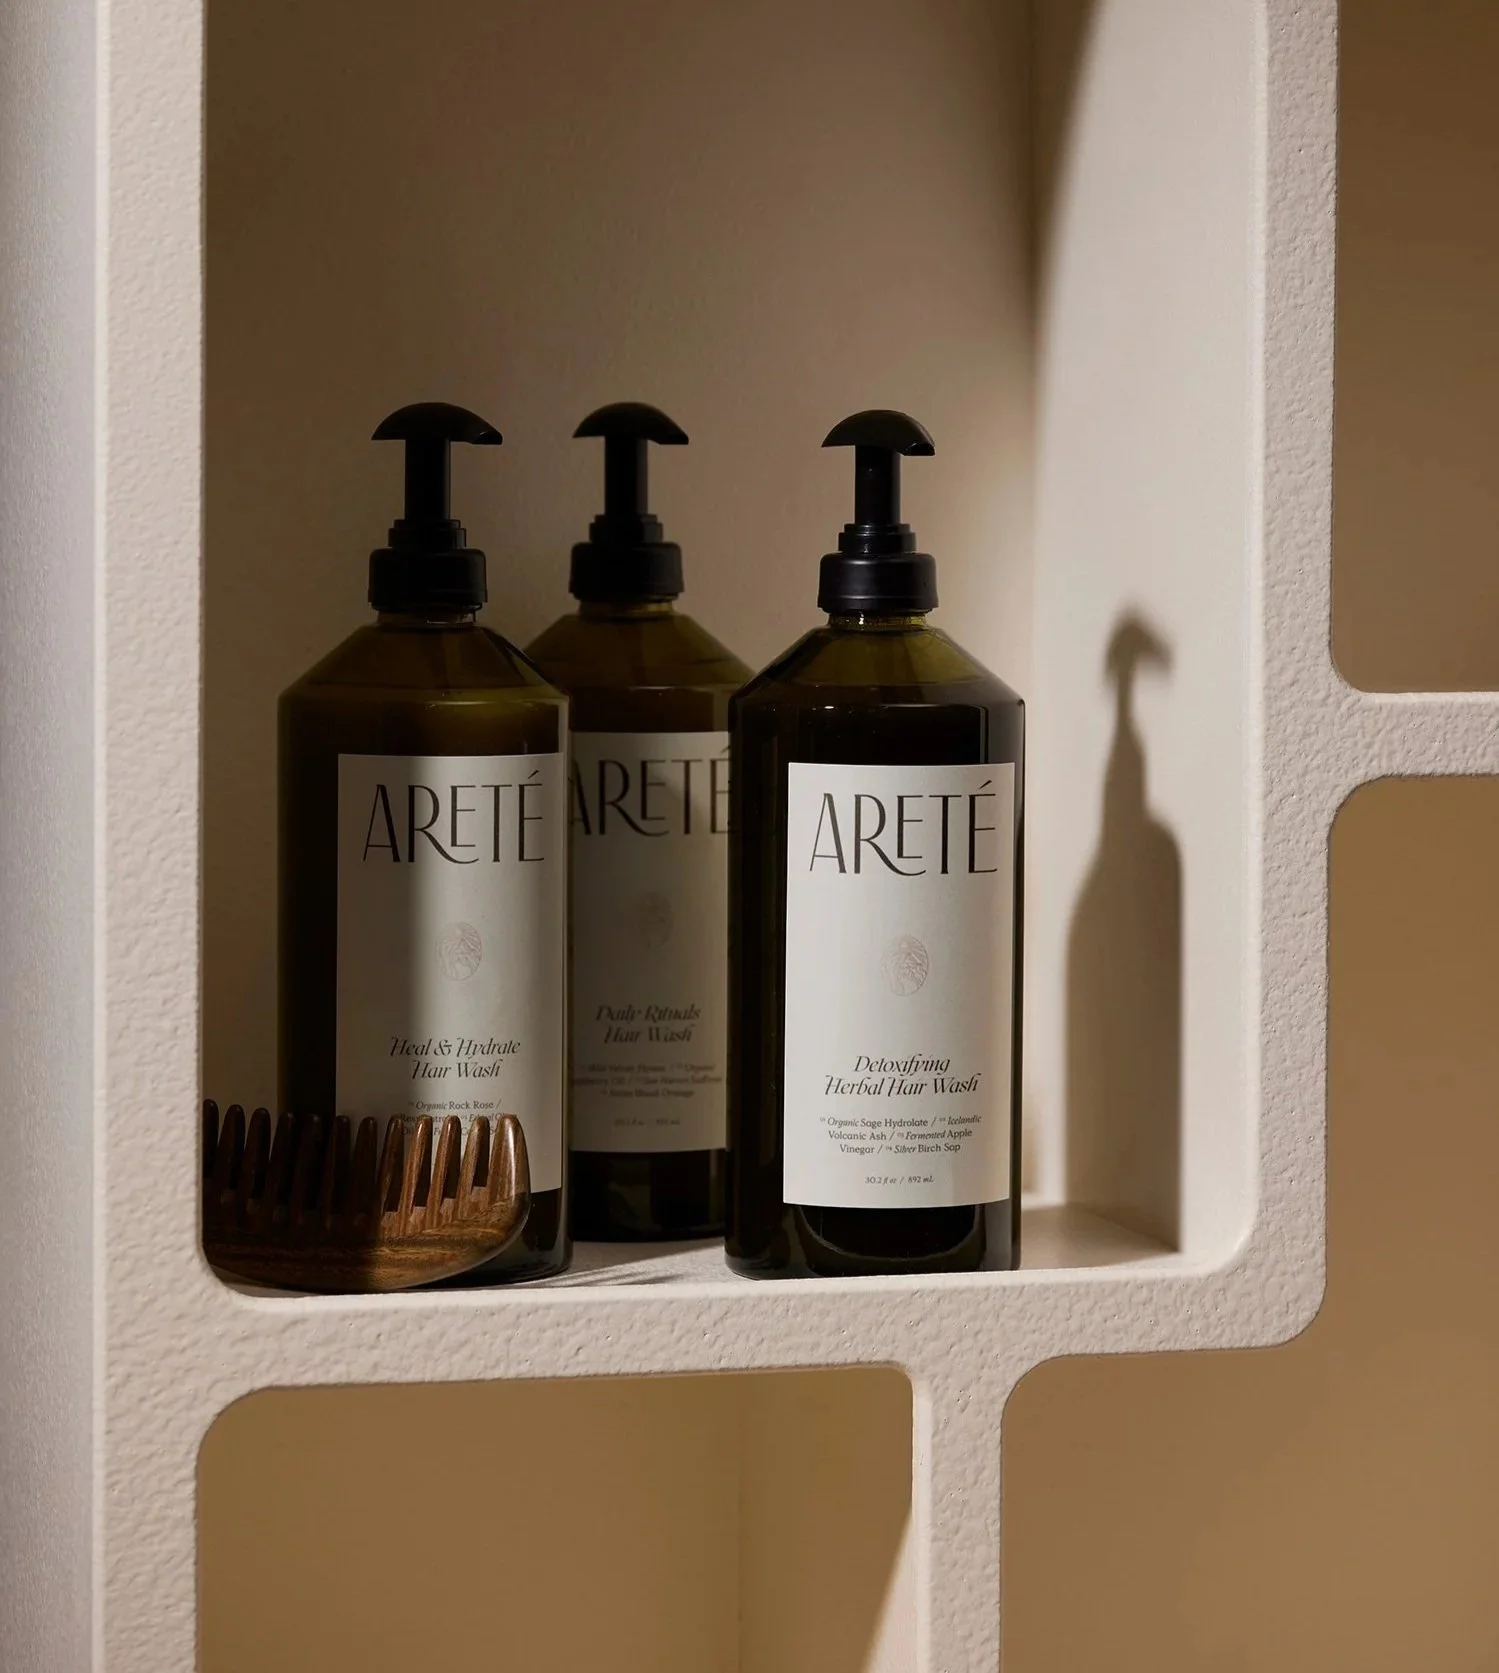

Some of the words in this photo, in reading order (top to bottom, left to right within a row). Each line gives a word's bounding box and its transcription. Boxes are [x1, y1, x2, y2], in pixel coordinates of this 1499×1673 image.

[363, 770, 545, 864] ARETÉ
[809, 780, 998, 876] ARETÉ
[595, 1004, 642, 1024] Daily
[644, 1003, 701, 1023] Rituals
[604, 1026, 641, 1043] Hair
[648, 1024, 696, 1042] Wash
[390, 1037, 432, 1057] Heal
[434, 1039, 452, 1056] &
[456, 1037, 521, 1060] Hydrate
[411, 1060, 451, 1079] Hair
[456, 1059, 503, 1078] Wash
[854, 1054, 951, 1077] Detoxifying
[825, 1075, 885, 1096] Herbal
[887, 1076, 927, 1097] Hair
[933, 1073, 982, 1094] Wash
[415, 1101, 448, 1112] Organic
[449, 1101, 470, 1110] Rock
[473, 1101, 494, 1110] Rose
[827, 1116, 859, 1129] Organic
[860, 1118, 882, 1130] Sage
[884, 1118, 928, 1130] Hydrolate
[947, 1114, 982, 1126] Icelandic
[828, 1130, 867, 1141] Volcanic
[869, 1130, 887, 1141] Ash
[905, 1130, 947, 1140] Fermented
[948, 1128, 972, 1141] Apple
[840, 1144, 875, 1155] Vinegar
[894, 1144, 917, 1154] Silver
[918, 1143, 942, 1153] Birch
[943, 1142, 961, 1154] Sap
[865, 1176, 882, 1184] 30.2
